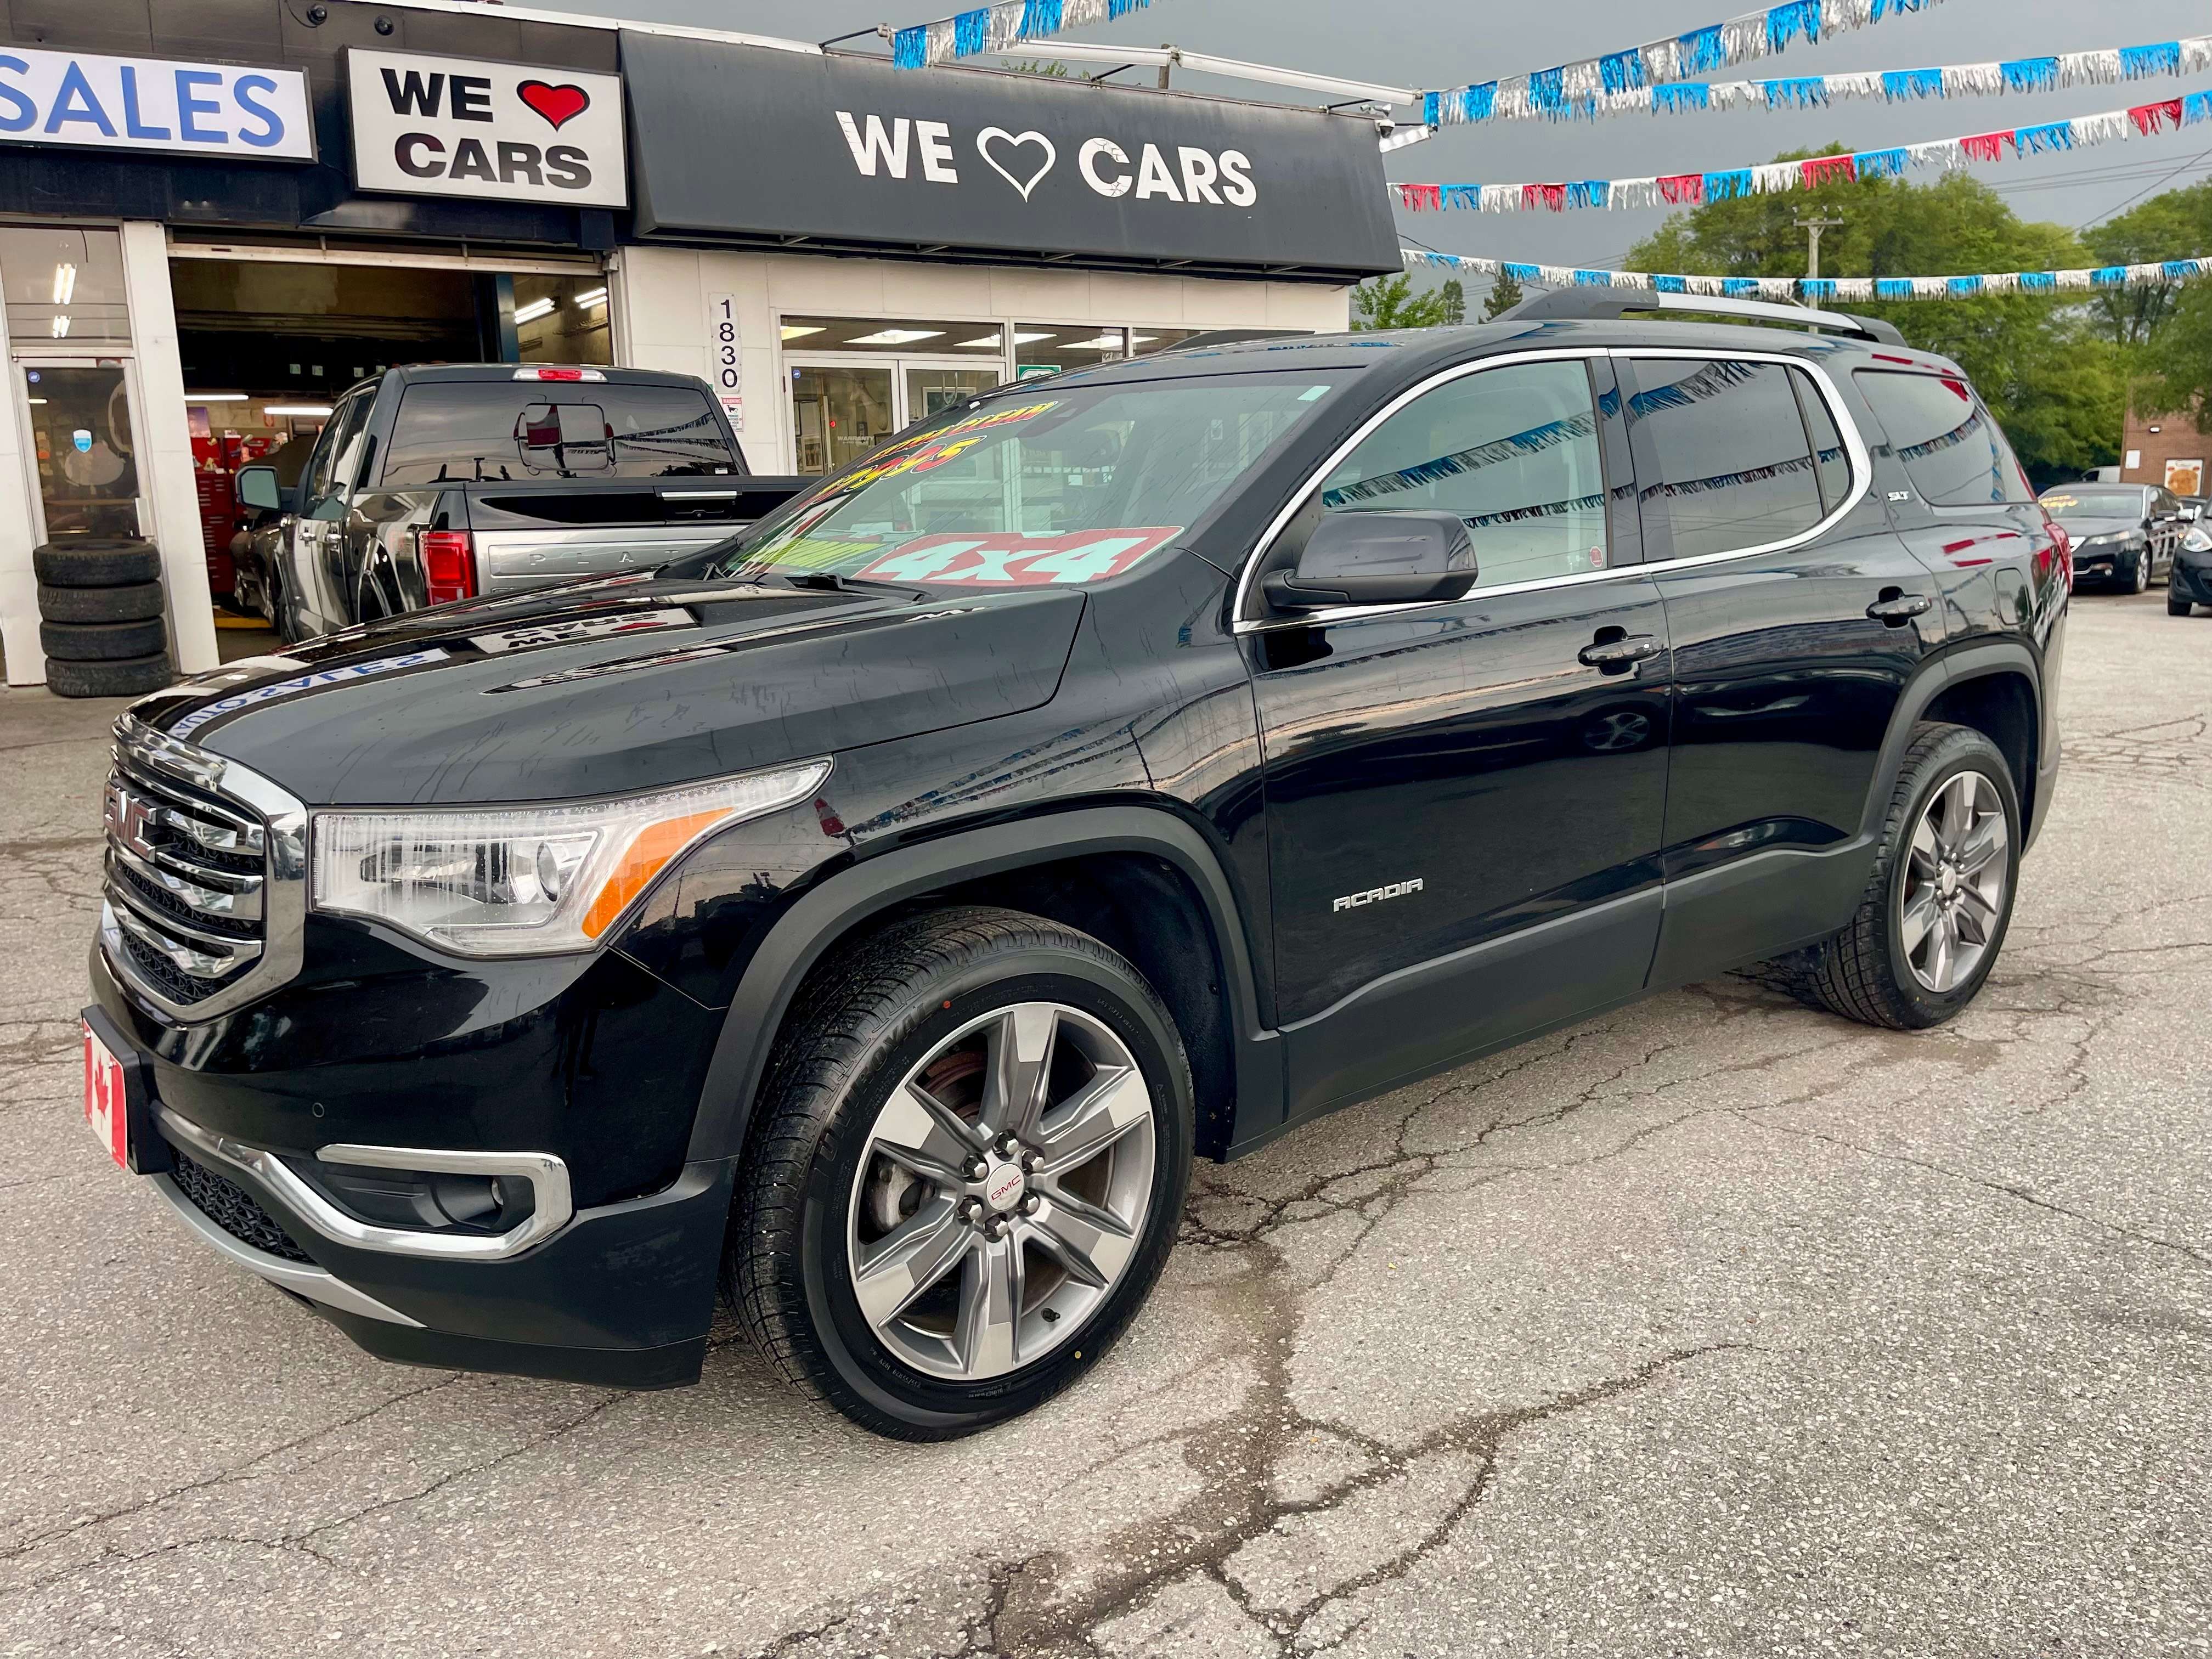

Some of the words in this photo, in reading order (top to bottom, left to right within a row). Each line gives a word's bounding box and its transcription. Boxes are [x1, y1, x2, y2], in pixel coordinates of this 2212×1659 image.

[0, 47, 285, 148] SALES
[380, 67, 494, 122] WE
[394, 132, 592, 190] CARS
[835, 111, 958, 184] WE
[1078, 138, 1257, 208] CARS
[720, 299, 738, 388] 1830
[1333, 878, 1423, 913] ACADIA
[991, 1175, 1021, 1200] GMC
